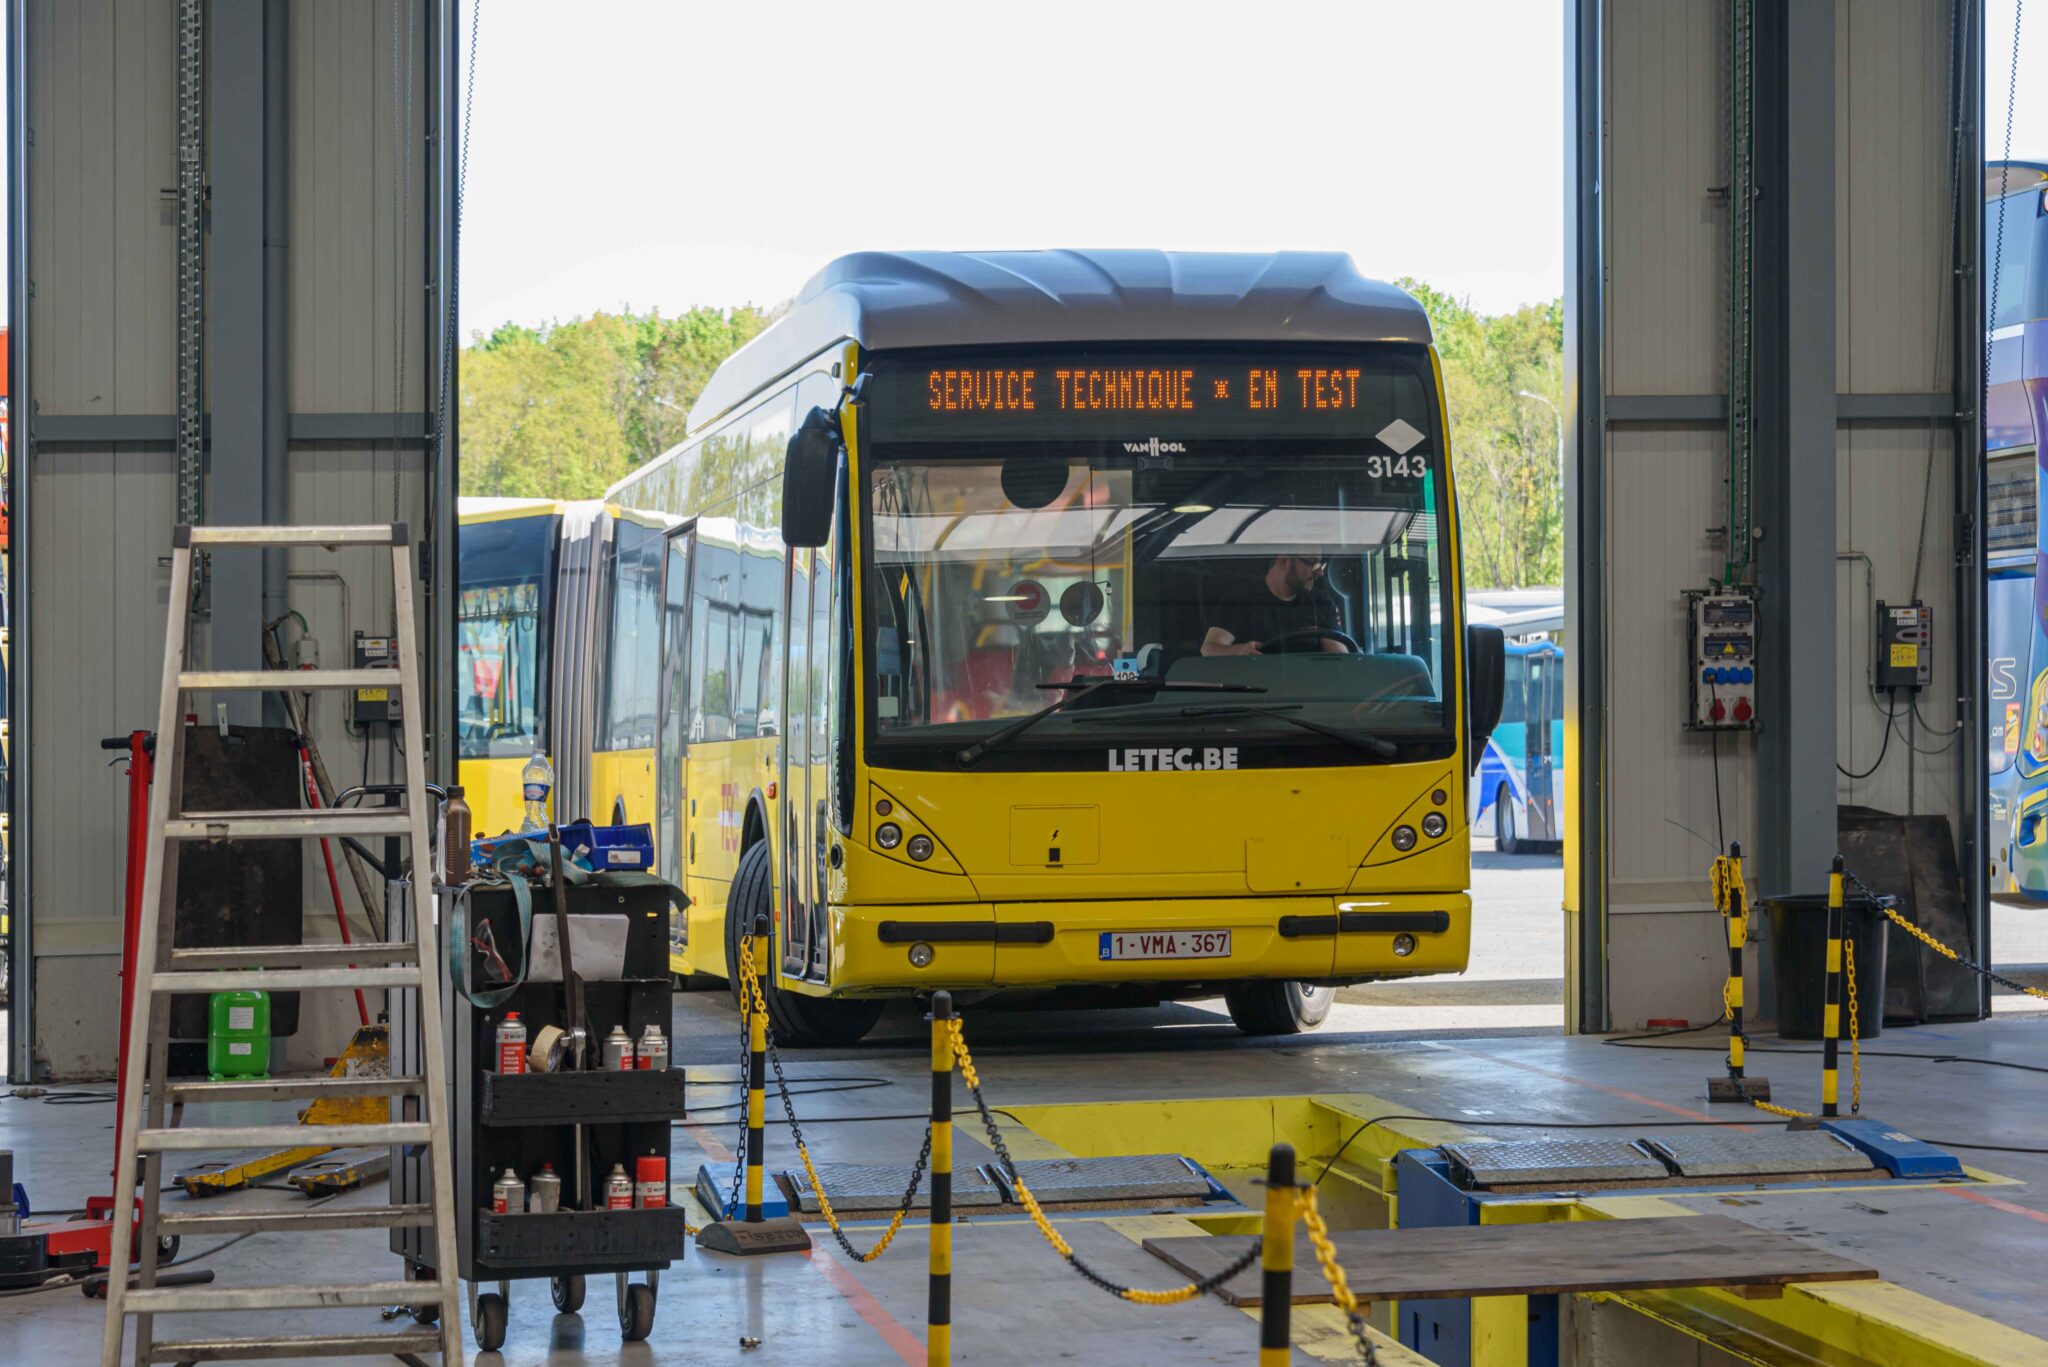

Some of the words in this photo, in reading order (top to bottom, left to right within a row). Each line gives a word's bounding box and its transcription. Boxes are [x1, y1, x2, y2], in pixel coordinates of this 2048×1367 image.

[929, 370, 1035, 410] SERVICE
[1056, 370, 1194, 410] TECHNIQUE
[1249, 369, 1278, 409] EN
[1297, 369, 1361, 409] TEST
[1367, 455, 1427, 479] 3143
[1108, 747, 1239, 772] LETEC.BE
[1115, 932, 1228, 956] 1-VMA-367
